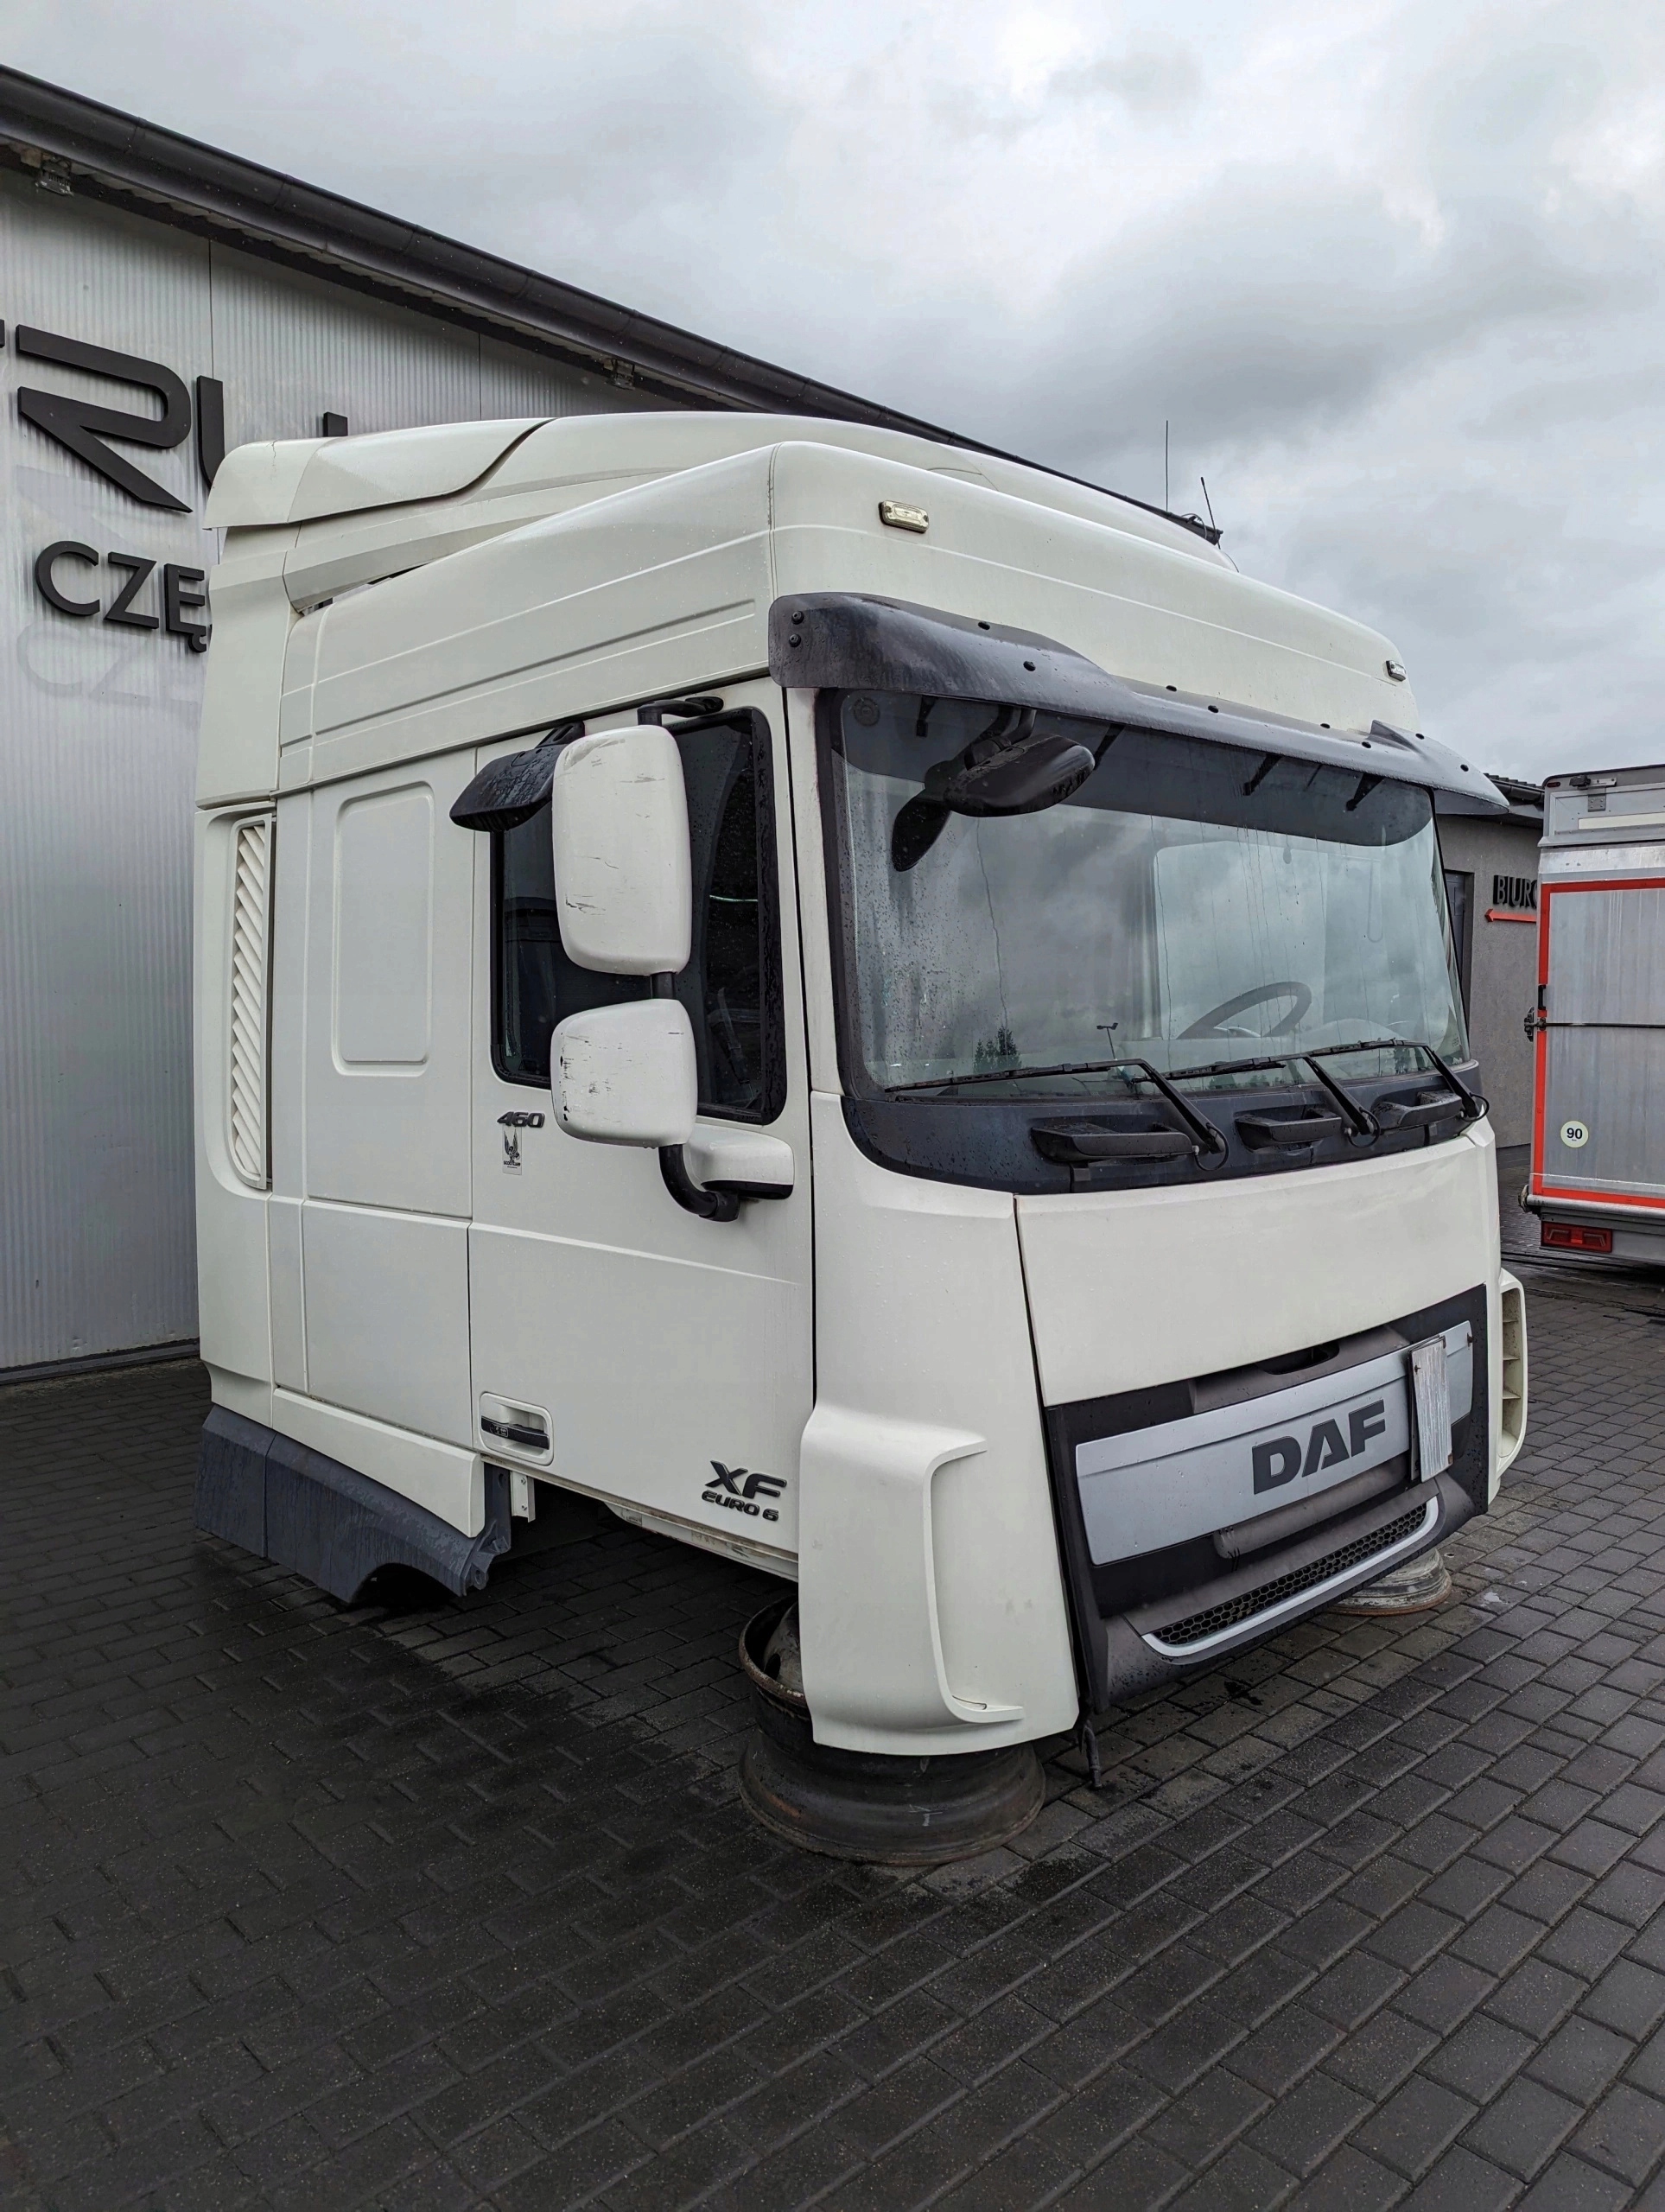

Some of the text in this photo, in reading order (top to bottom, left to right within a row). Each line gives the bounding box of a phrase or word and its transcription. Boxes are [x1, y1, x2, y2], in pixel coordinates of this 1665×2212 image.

[35, 540, 213, 653] CZĘ
[497, 1111, 545, 1128] 460
[1566, 1128, 1583, 1140] 90
[1252, 1399, 1386, 1495] DAF
[704, 1460, 787, 1499] XF
[702, 1490, 779, 1522] EURO 6
